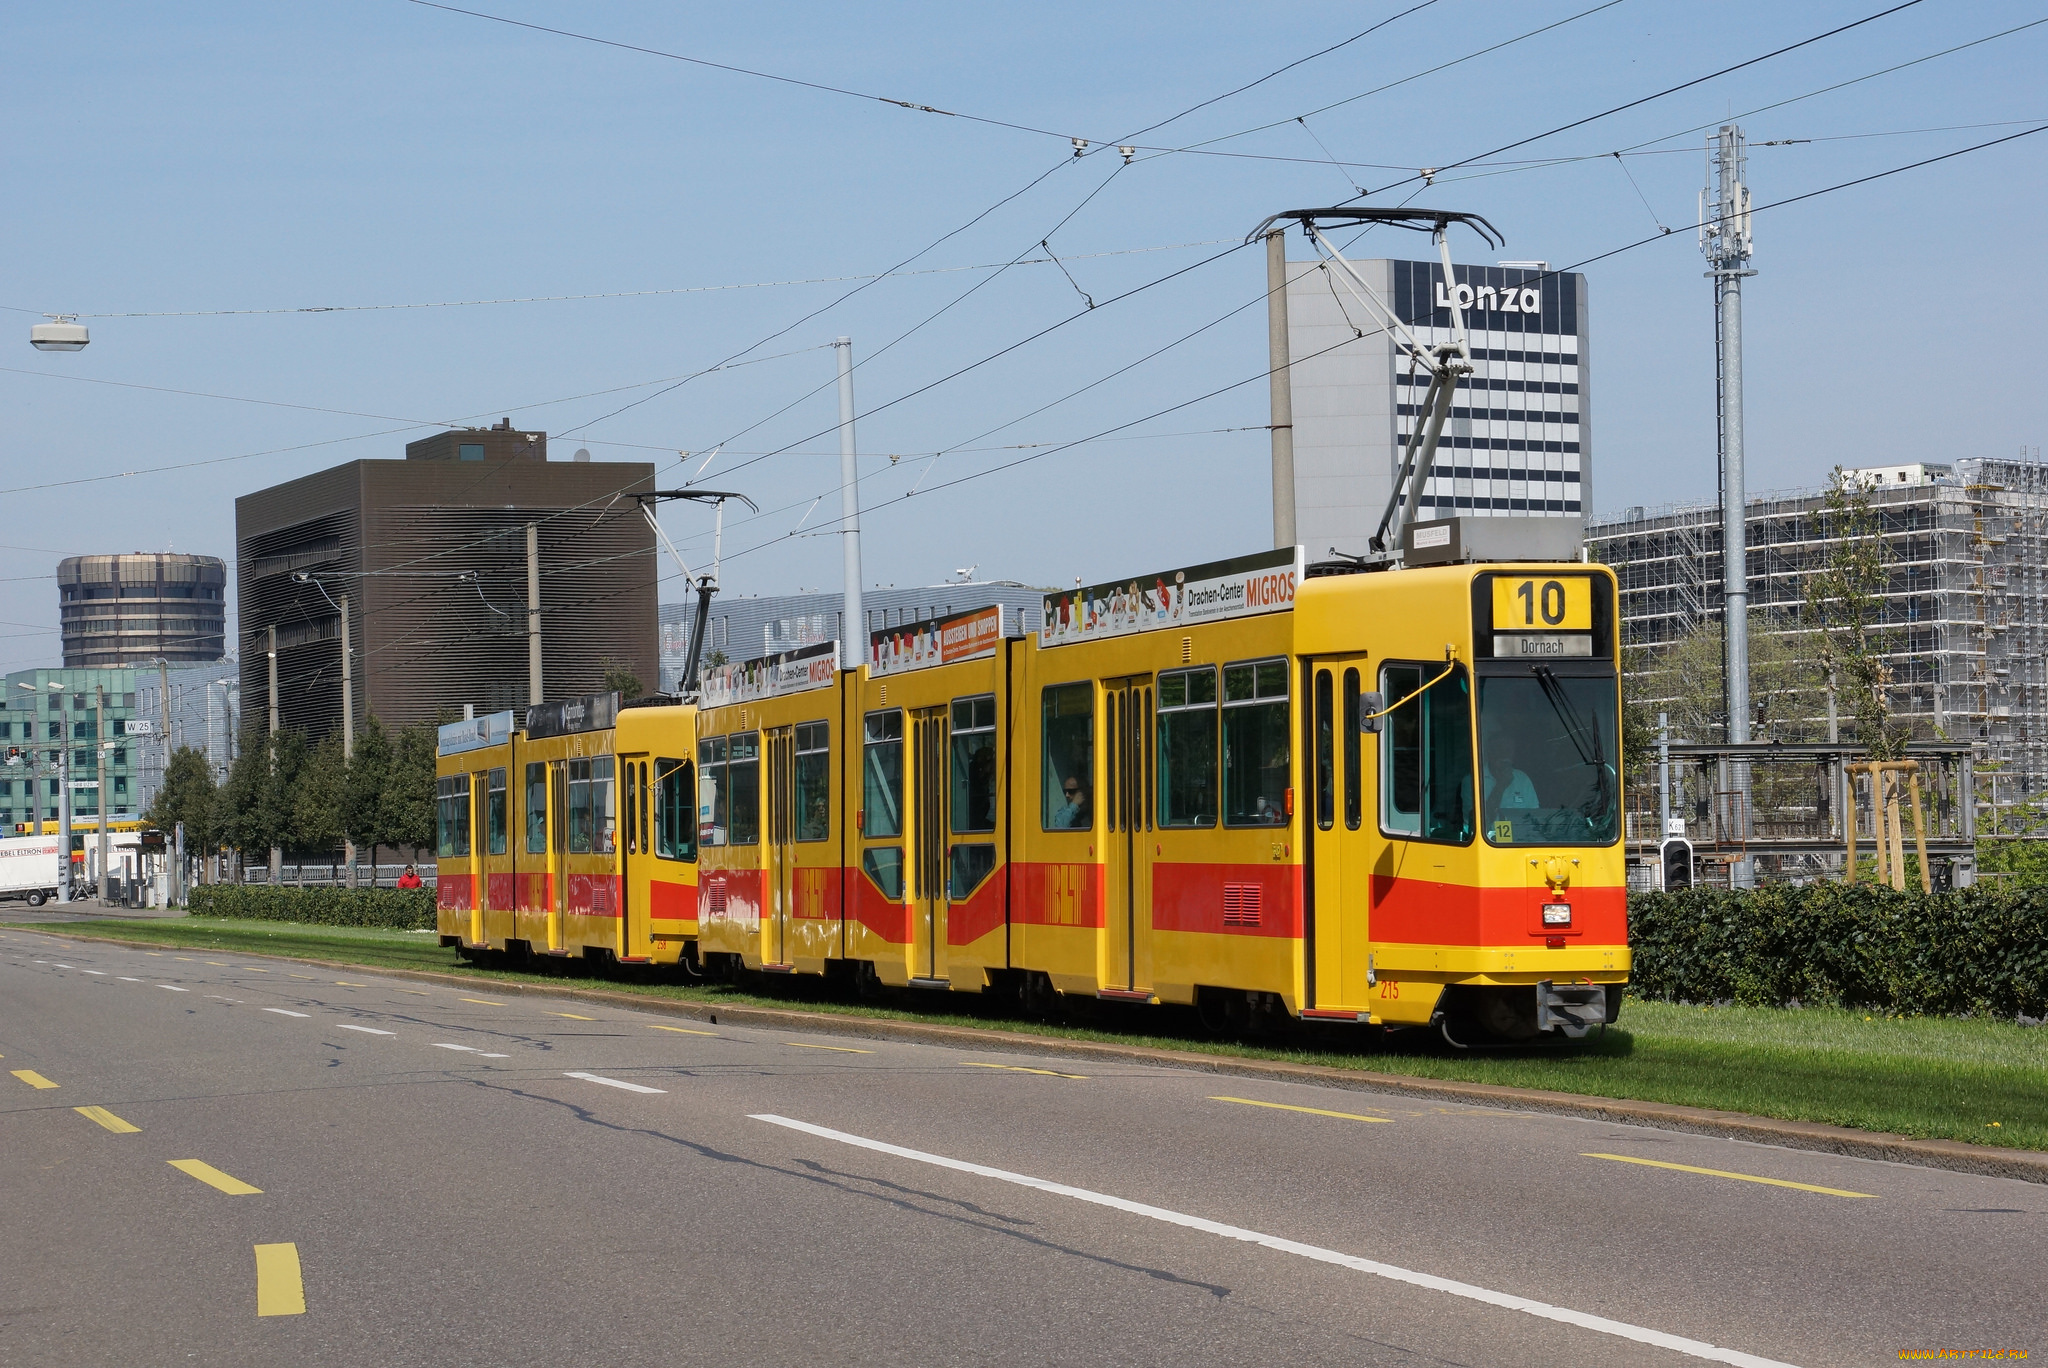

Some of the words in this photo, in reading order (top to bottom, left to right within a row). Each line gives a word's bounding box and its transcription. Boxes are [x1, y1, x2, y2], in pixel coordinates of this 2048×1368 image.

[1436, 282, 1540, 314] Lonza
[1188, 582, 1244, 606] Drachen-Center
[1246, 571, 1295, 607] MIGROS
[1518, 581, 1565, 625] 10
[943, 624, 968, 646] AUSSTEIGEN
[977, 615, 998, 636] SHOPPEN
[1521, 639, 1564, 653] Dornach
[809, 657, 834, 683] MIGROS
[127, 723, 136, 731] W
[139, 722, 149, 731] 25
[1496, 824, 1511, 838] 12
[1669, 821, 1674, 831] K
[1380, 979, 1399, 999] 215
